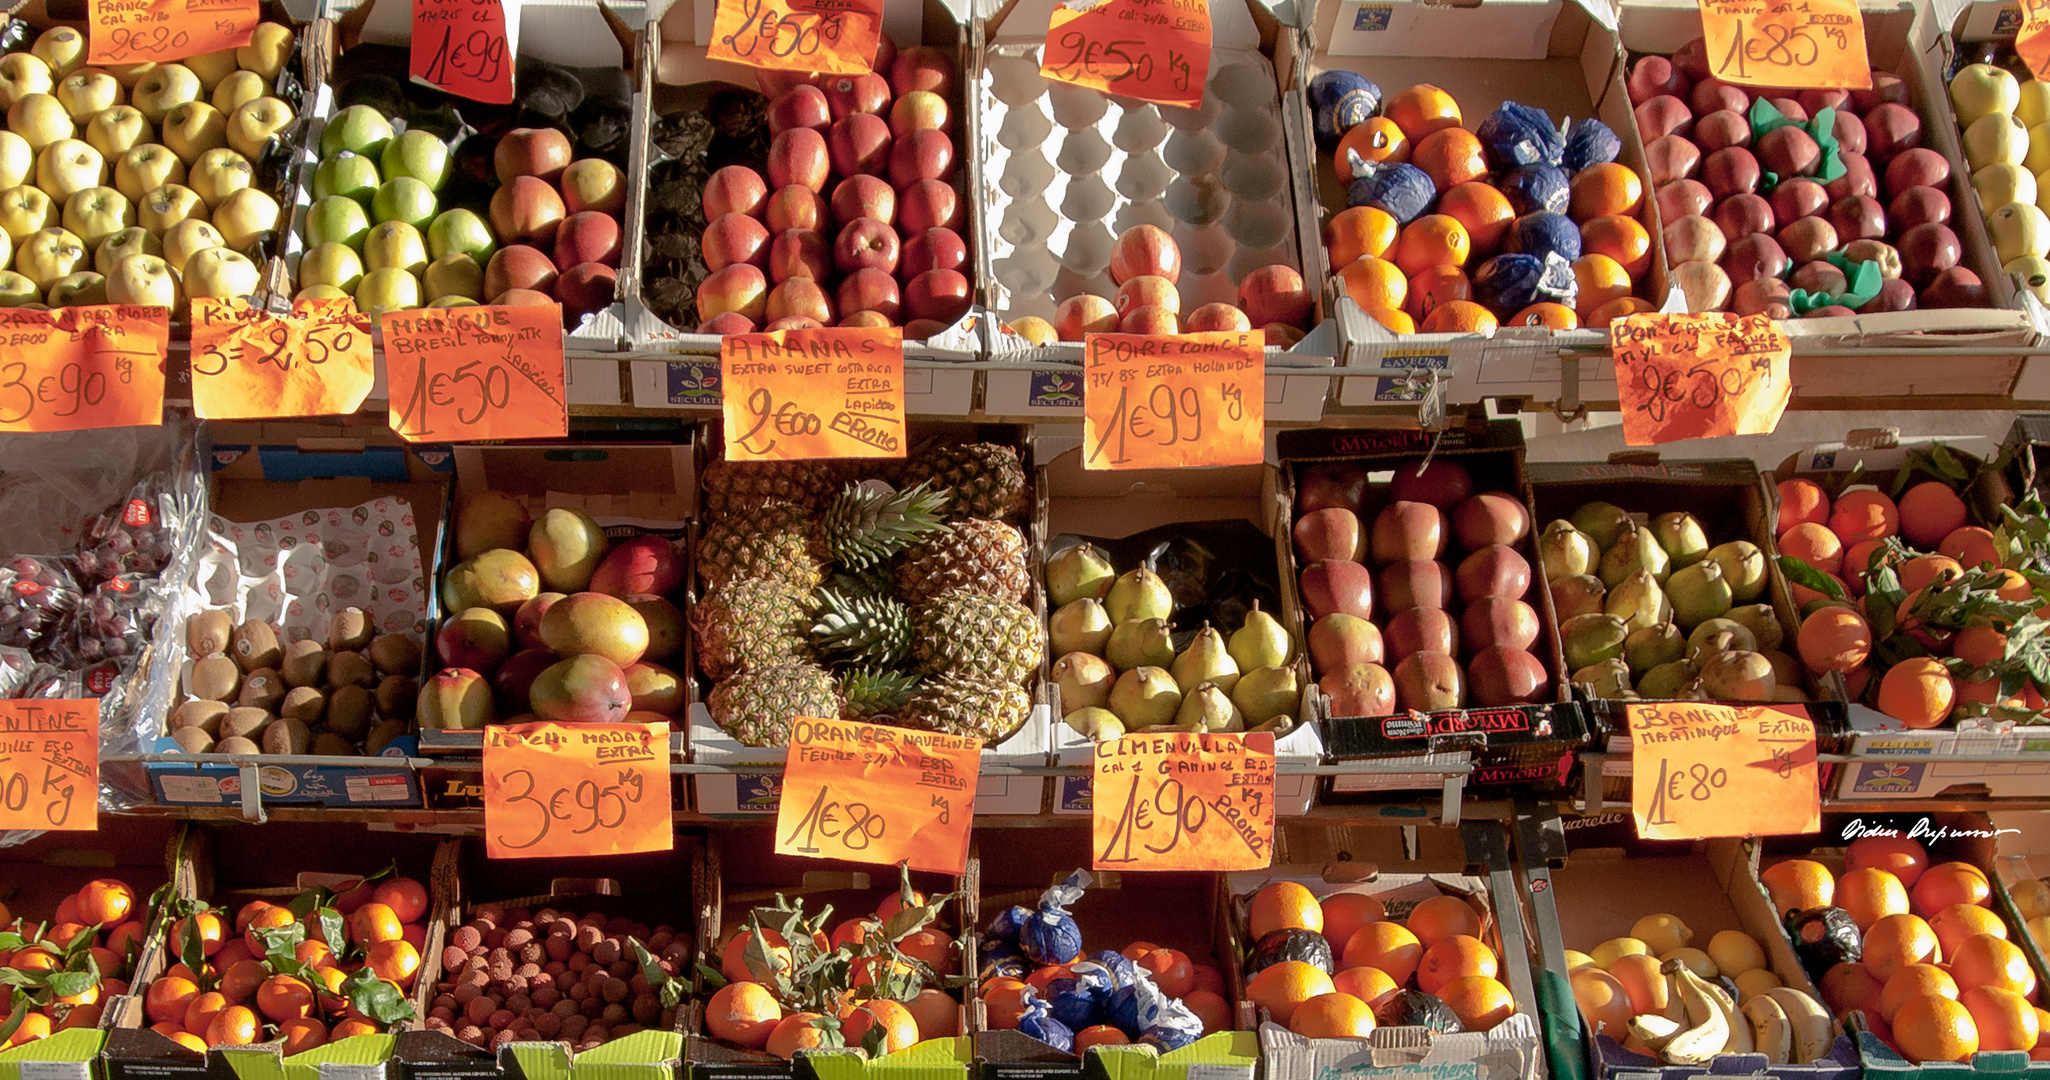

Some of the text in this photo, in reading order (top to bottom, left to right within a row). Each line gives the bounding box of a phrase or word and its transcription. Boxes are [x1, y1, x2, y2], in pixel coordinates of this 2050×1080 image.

[99, 14, 126, 25] CAL
[1771, 3, 1794, 15] CAT
[1809, 14, 1853, 24] EXTRA
[214, 19, 236, 35] Kg
[722, 0, 820, 57] 2€50
[821, 12, 843, 40] Kg
[1174, 17, 1205, 31] EXTRA
[98, 26, 188, 61] 2€20
[423, 25, 504, 85] 1€99
[1718, 19, 1847, 78] 1€85 Kg
[1048, 31, 1190, 92] 2€50 Kg
[82, 308, 113, 323] RED
[117, 307, 162, 321] GLOBE
[391, 310, 511, 335] MANGUE
[69, 325, 126, 343] EXTRA
[728, 337, 875, 361] ANANAS
[1089, 337, 1172, 368] POIRE
[115, 357, 133, 384] Kg
[731, 363, 777, 376] EXTRA
[785, 362, 832, 376] SWEET
[866, 363, 892, 375] RICA
[1146, 364, 1182, 378] EXTRA
[1193, 358, 1254, 373] HOLLANDE
[0, 362, 106, 423] 3€90
[395, 356, 510, 435] 1€50
[846, 377, 891, 390] EXTRA
[1637, 359, 1742, 422] 2€50
[732, 387, 821, 455] 2€00
[830, 412, 898, 452] PROMO
[1088, 383, 1242, 464] 1€99 Kg
[138, 505, 146, 521] PLU
[794, 721, 897, 745] ORANGES
[1633, 708, 1748, 730] BANANE
[1759, 719, 1811, 735] EXTRA
[1641, 723, 1740, 744] MARTINIQUE
[596, 746, 654, 759] EXTRA
[1772, 748, 1797, 779] Kg
[1102, 762, 1124, 773] CAL
[1481, 765, 1553, 781] MYLORD
[42, 764, 74, 826] Kg
[498, 767, 643, 849] 3€95 Kg
[1242, 787, 1263, 817] Kg
[1644, 758, 1727, 831] 1€80
[784, 785, 885, 854] 1€80
[931, 794, 950, 825] Kg
[1098, 775, 1206, 863] 1€90
[1213, 795, 1264, 851] PROMO
